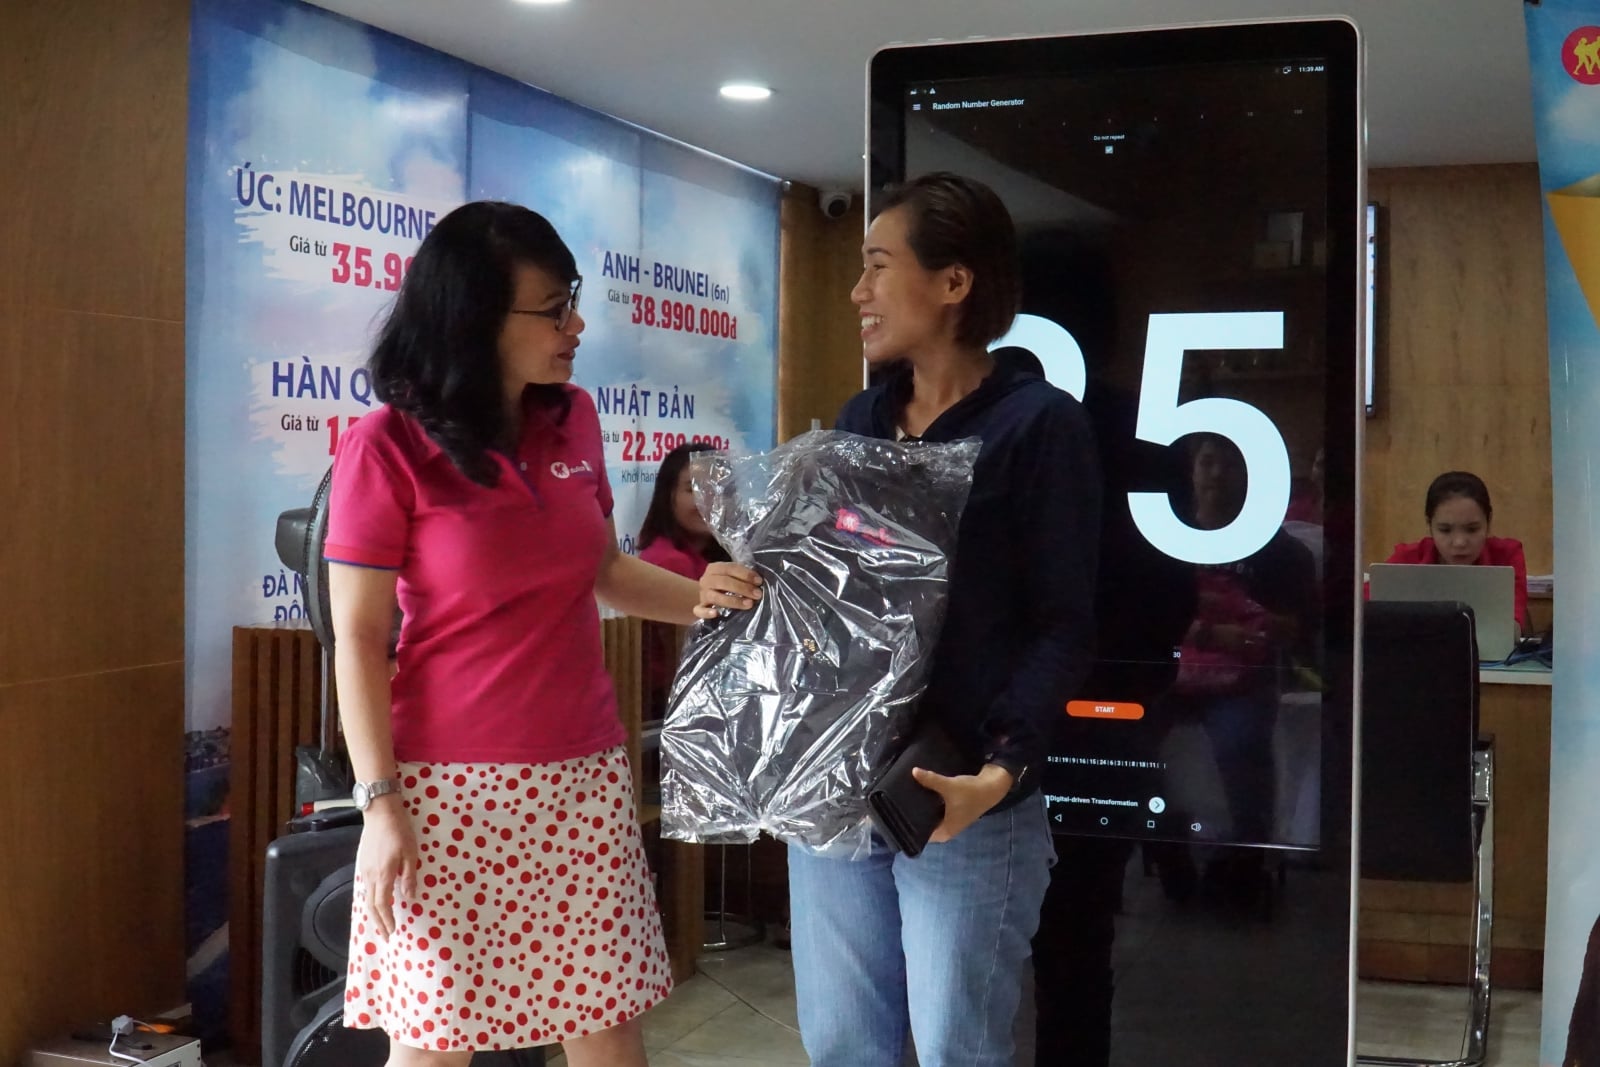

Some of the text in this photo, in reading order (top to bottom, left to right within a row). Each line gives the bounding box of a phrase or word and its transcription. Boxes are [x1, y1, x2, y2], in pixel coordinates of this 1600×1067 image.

[932, 98, 1025, 111] Random Number Generator
[237, 162, 437, 241] ÚC: MELBOURNE
[290, 235, 310, 255] Giá
[602, 250, 641, 284] ANH
[653, 261, 709, 298] BRUNEI
[711, 282, 730, 304] (6n)
[631, 293, 737, 339] 38.990.000đ
[272, 355, 341, 400] HÀN
[597, 384, 695, 424] NHẬT BẢN
[281, 413, 302, 431] Giá
[262, 568, 289, 598] ĐÀ
[1049, 795, 1138, 807] Digital-driven Transformation
